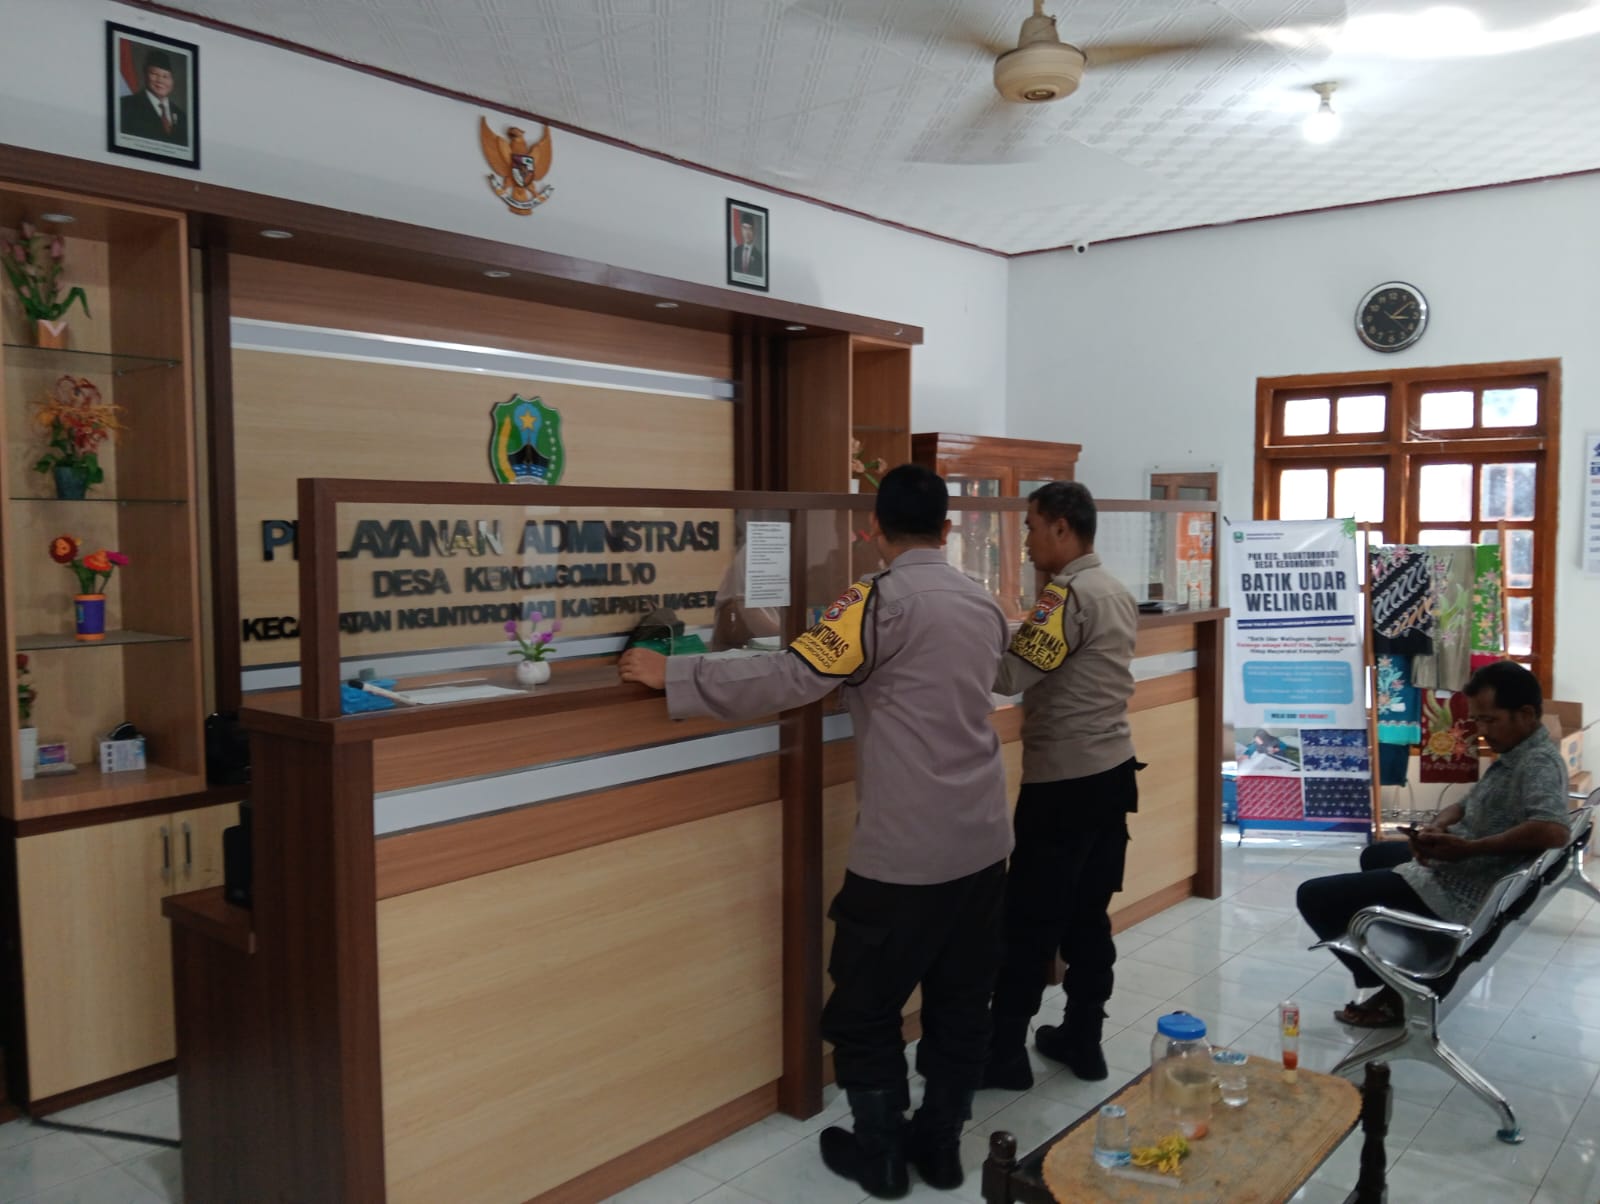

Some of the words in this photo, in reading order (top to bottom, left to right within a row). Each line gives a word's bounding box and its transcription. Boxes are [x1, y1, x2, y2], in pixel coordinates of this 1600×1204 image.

[261, 519, 503, 561] PAYANAN
[372, 567, 452, 598] DESA
[1241, 572, 1293, 592] BATIK
[1299, 571, 1347, 592] UDAR
[1246, 592, 1338, 612] WELINGAN
[242, 609, 392, 642] KECATAN
